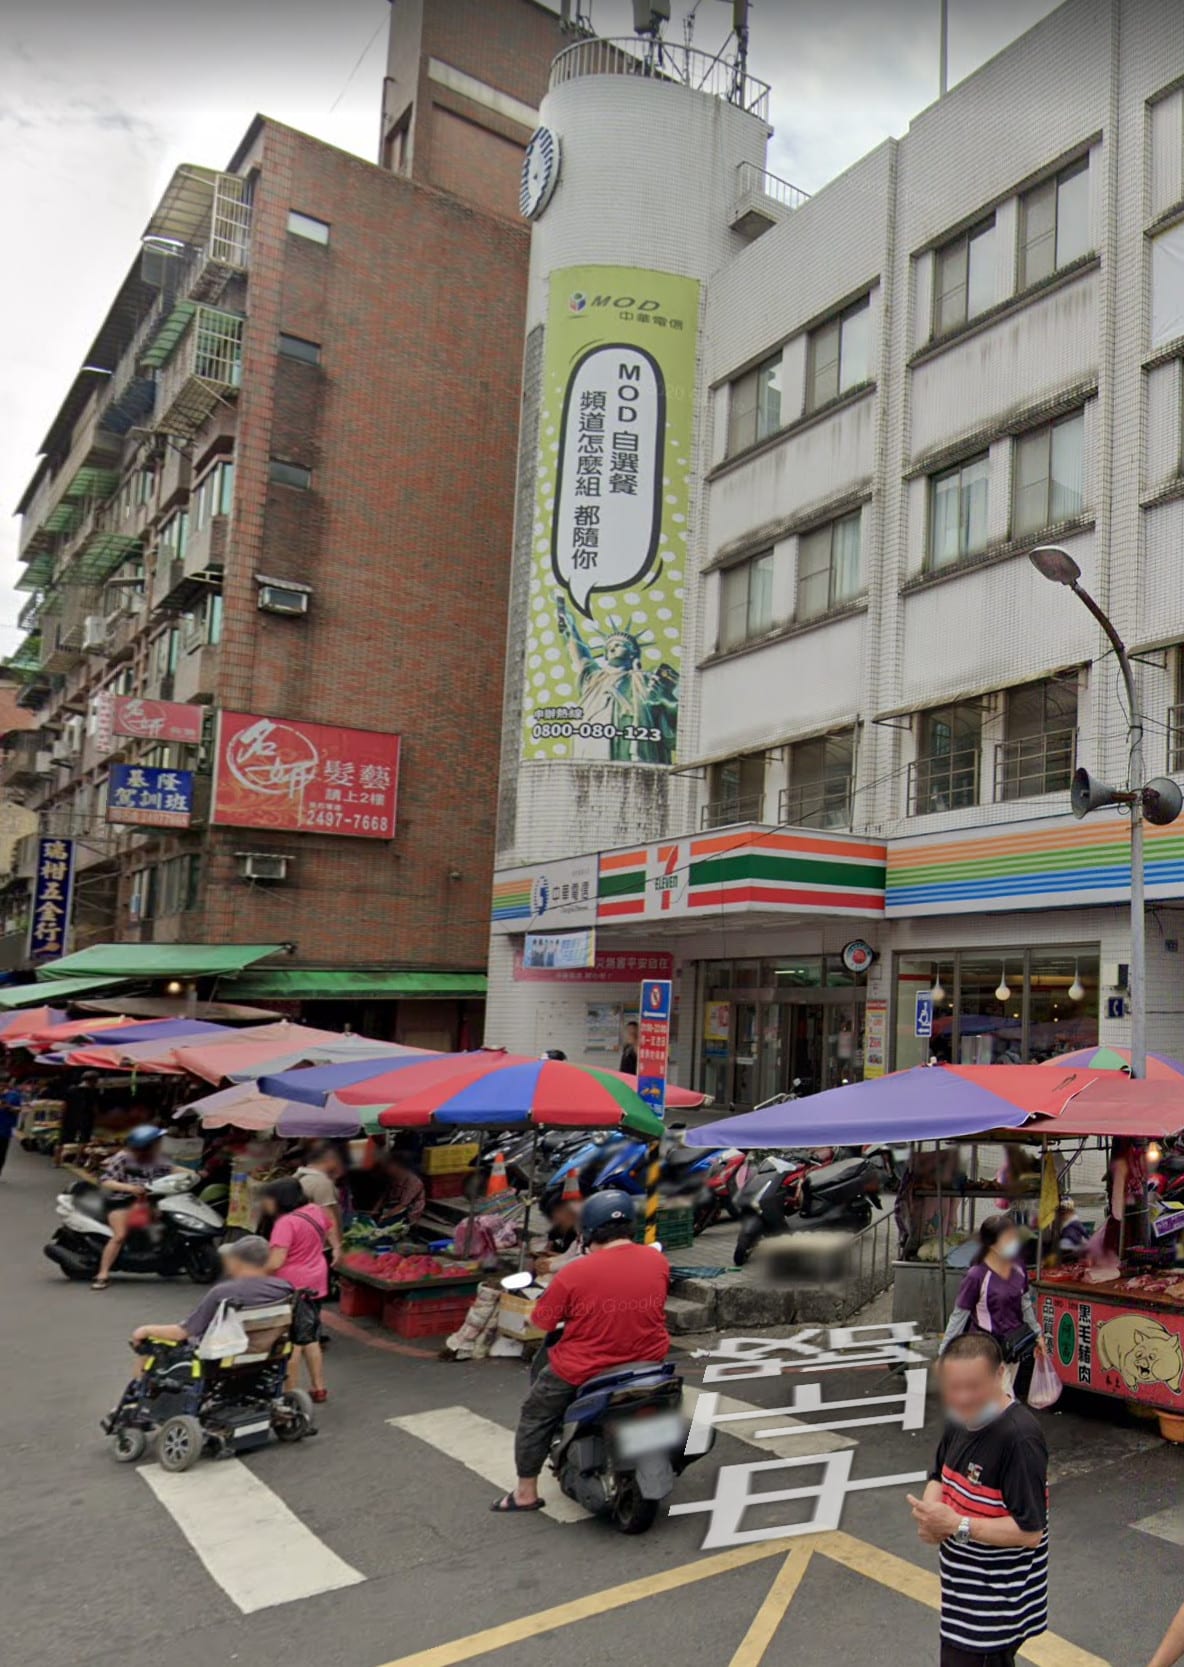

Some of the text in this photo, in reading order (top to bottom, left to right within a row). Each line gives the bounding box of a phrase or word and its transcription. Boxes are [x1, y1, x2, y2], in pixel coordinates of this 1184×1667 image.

[591, 296, 661, 312] MOD
[620, 311, 684, 331] 中華電信
[609, 363, 641, 496] MOD 自選餐
[571, 390, 607, 570] 頻道怎麼組 都隨你
[532, 724, 662, 741] 0800-080-123
[125, 769, 182, 791] 基隆
[323, 759, 391, 791] 髮藝
[113, 785, 189, 811] 駕訓班
[307, 811, 389, 832] 2497-7668
[655, 874, 679, 891] ELEVEN
